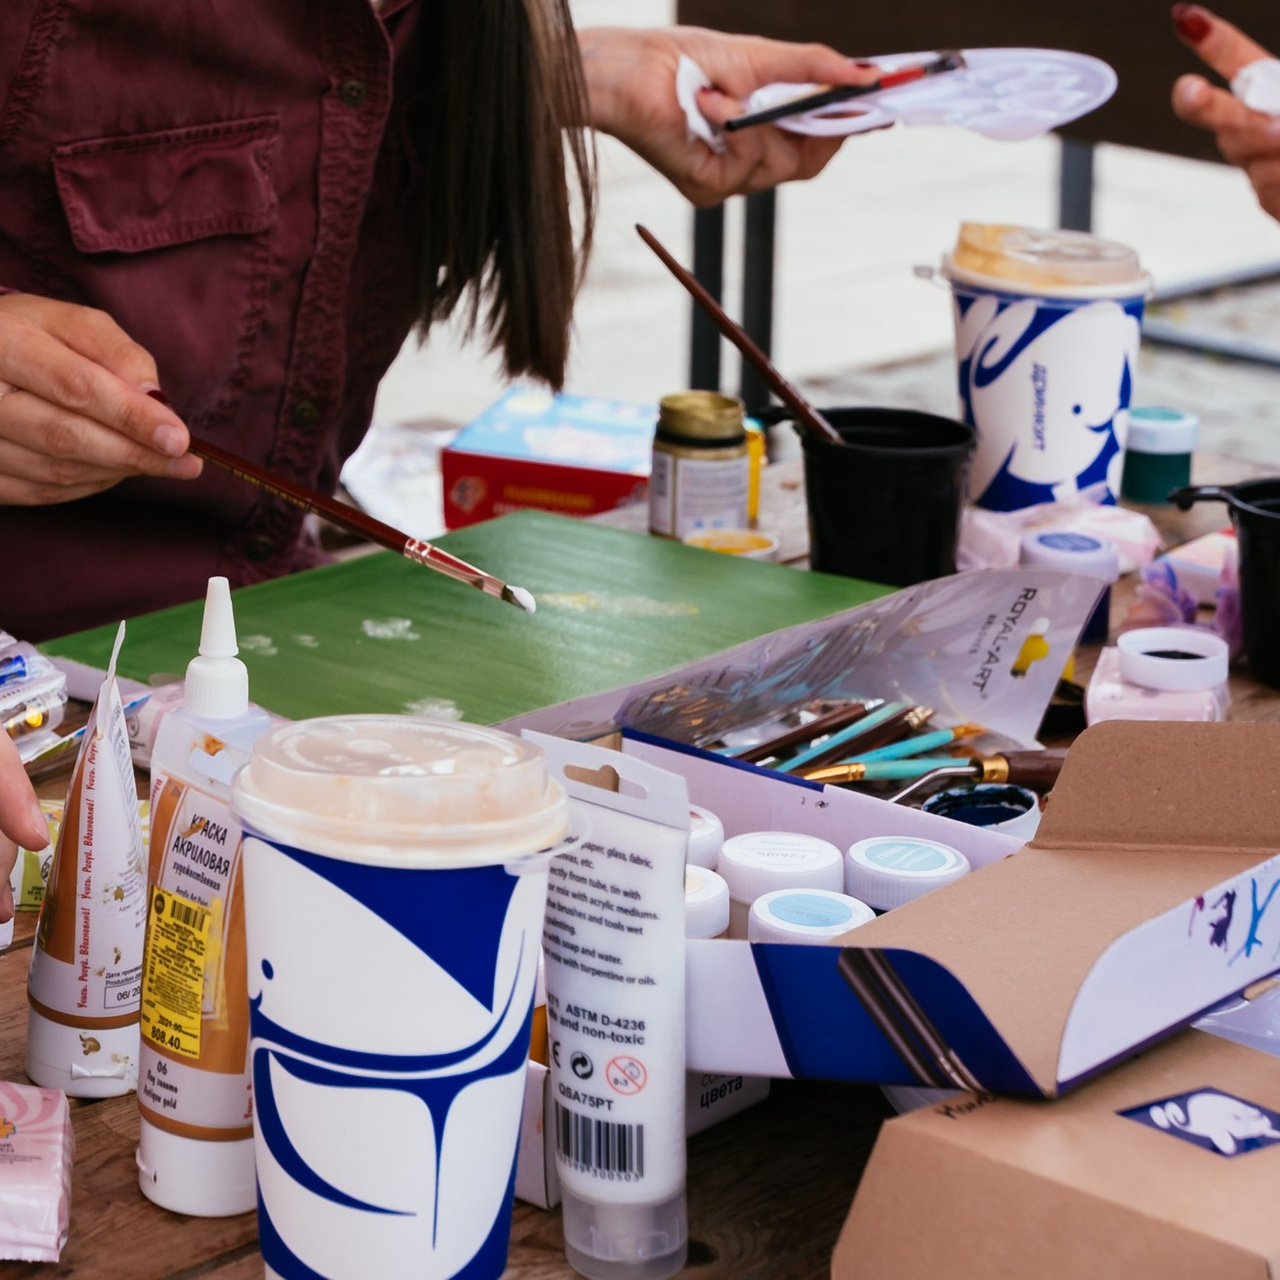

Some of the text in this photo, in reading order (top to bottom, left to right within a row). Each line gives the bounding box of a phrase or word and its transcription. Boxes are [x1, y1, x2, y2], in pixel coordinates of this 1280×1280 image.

[972, 587, 1038, 693] ROYAL-ART
[83, 798, 95, 846] Вдохновляй!
[82, 849, 95, 872] Рисуй.
[81, 875, 92, 900] Учись.
[173, 861, 221, 891] художественная
[550, 866, 568, 880] ectly
[569, 871, 588, 884] from
[622, 889, 642, 901] with
[556, 885, 570, 897] mix
[571, 892, 588, 903] with
[589, 897, 615, 911] acrylic
[616, 905, 660, 920] mediums.
[79, 907, 91, 955] Вдохновляй!
[557, 902, 587, 918] brushes
[587, 914, 603, 925] and
[605, 918, 626, 932] tools
[627, 925, 643, 935] wet
[562, 940, 580, 953] soap
[580, 945, 596, 958] and
[597, 952, 623, 965] water.
[78, 959, 91, 981] Рисуй.
[105, 965, 141, 980] Дата произво
[105, 976, 134, 986] Production
[563, 957, 580, 970] with
[580, 962, 624, 983] turpentine
[626, 976, 636, 984] or
[638, 976, 657, 986] oils.
[78, 983, 88, 1008] Учись.
[131, 985, 141, 997] 20
[560, 1016, 579, 1032] and
[582, 1027, 645, 1046] non-toxic
[566, 1003, 598, 1023] ASTM
[601, 1015, 646, 1031] D-4236
[151, 1026, 180, 1050] 808.40
[157, 1061, 168, 1075] 06
[143, 1085, 177, 1109] Antique gold
[558, 1083, 614, 1111] QSA75PT
[700, 1076, 743, 1109] цвета
